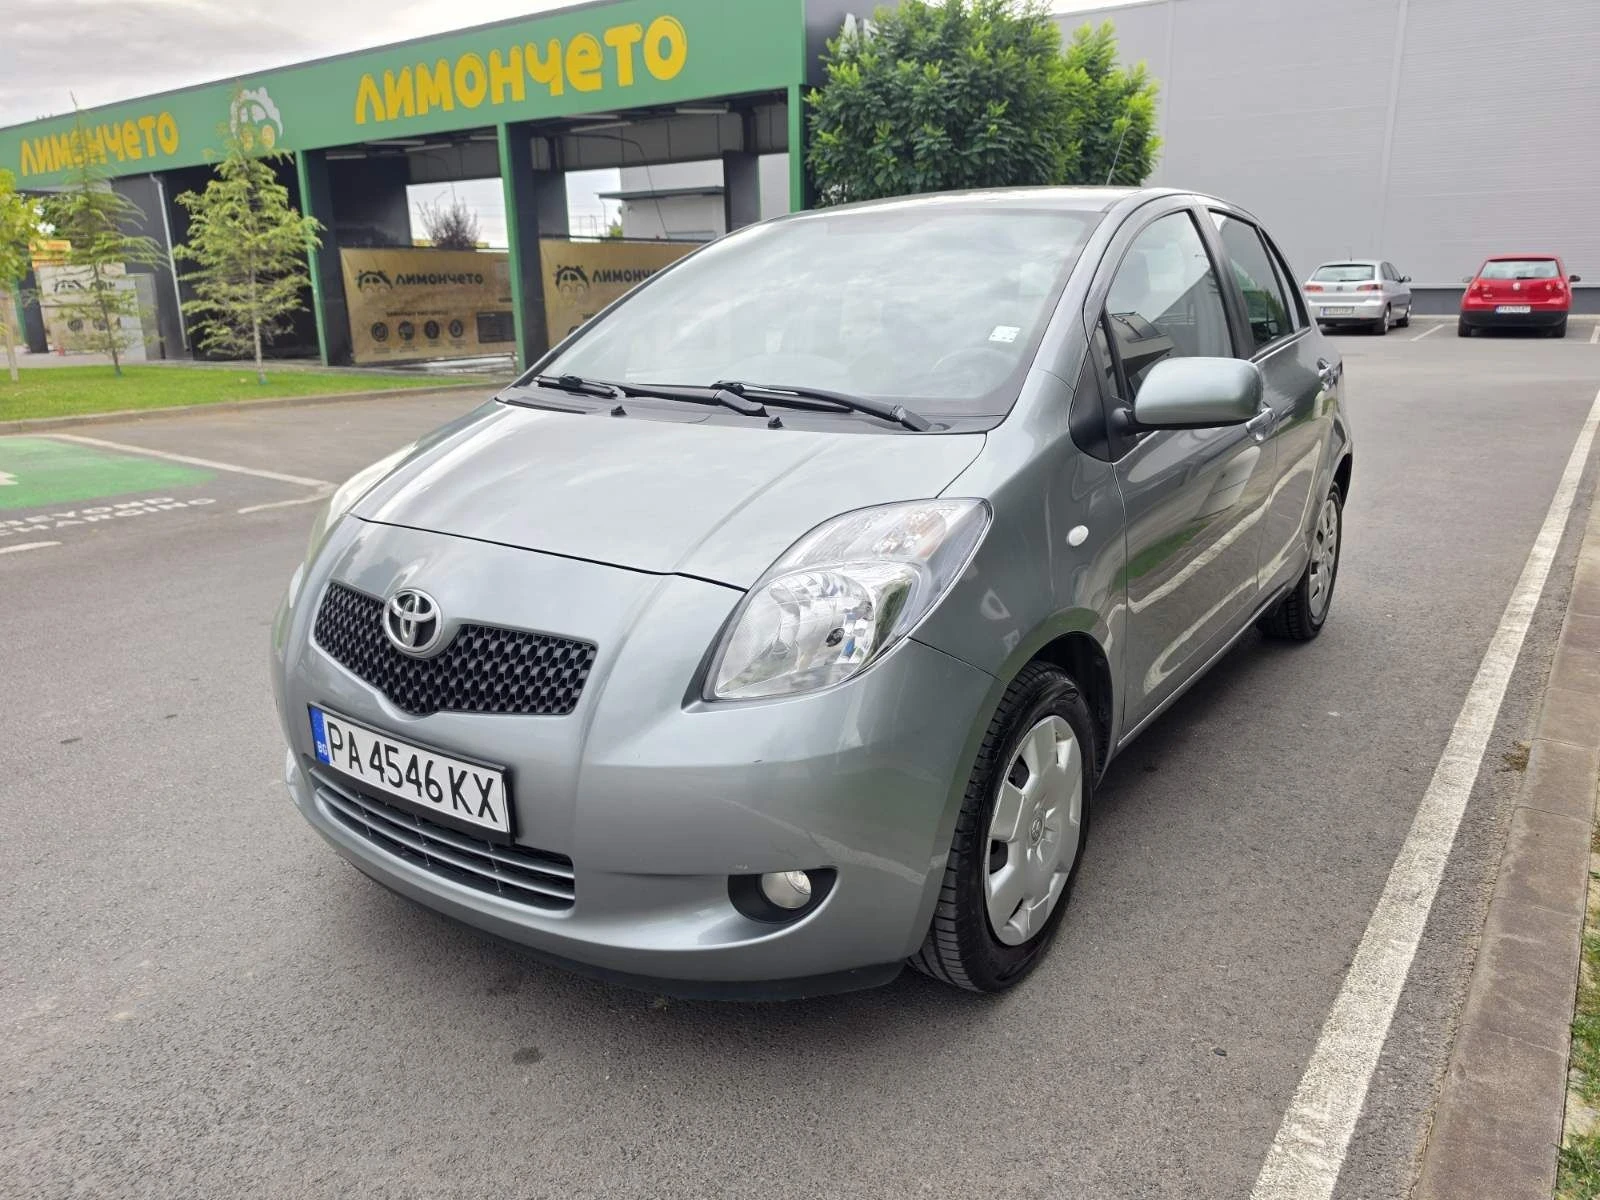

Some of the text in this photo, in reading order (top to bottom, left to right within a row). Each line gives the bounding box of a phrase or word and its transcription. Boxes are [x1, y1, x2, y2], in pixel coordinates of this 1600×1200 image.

[316, 741, 328, 756] BG
[369, 741, 443, 803] 4546
[448, 766, 498, 823] KX
